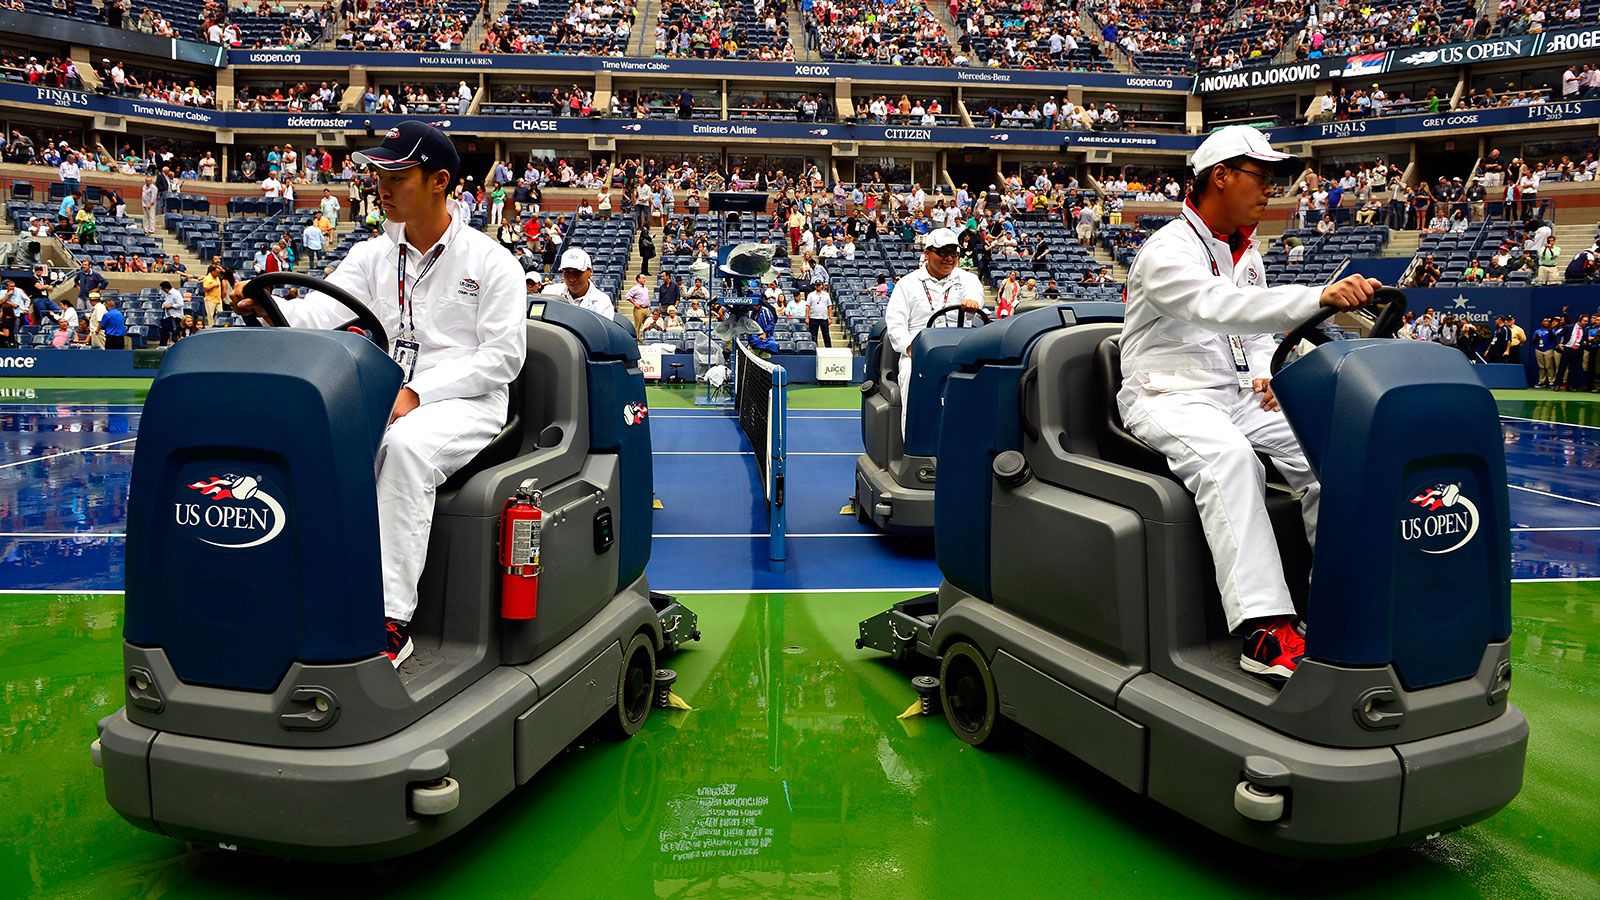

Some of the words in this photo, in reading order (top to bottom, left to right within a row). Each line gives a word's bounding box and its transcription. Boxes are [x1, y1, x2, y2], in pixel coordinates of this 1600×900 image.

[1440, 46, 1464, 63] US
[1466, 40, 1523, 60] OPEN
[250, 54, 301, 64] usopen.org
[602, 61, 620, 69] Time
[620, 61, 646, 69] Warner
[647, 62, 668, 70] Cable
[794, 65, 830, 75] xerox
[958, 72, 1010, 81] Mercedes-Benz
[1252, 64, 1320, 86] DJOKOVIC
[1126, 78, 1173, 88] usopen.org
[37, 88, 88, 105] FINALS
[133, 104, 154, 114] Time
[155, 108, 184, 118] Warner
[186, 111, 209, 122] Cable
[1528, 102, 1582, 118] FINALS
[287, 116, 349, 127] ticketmaster
[1423, 117, 1445, 127] GREY
[1447, 115, 1479, 125] GOOSE
[1545, 113, 1562, 121] 2015
[513, 120, 557, 131] CHASE
[693, 125, 728, 134] Emirates
[730, 125, 757, 135] Airline
[1322, 121, 1366, 136] FINALS
[884, 128, 932, 140] CITIZEN
[1077, 136, 1120, 144] AMERICAN
[1121, 137, 1157, 145] EXPRESS
[1433, 311, 1489, 322] Hneken
[824, 364, 846, 375] juice
[175, 503, 200, 526] US
[205, 505, 269, 531] OPEN
[1400, 517, 1422, 541] US
[1424, 511, 1468, 537] OPEN
